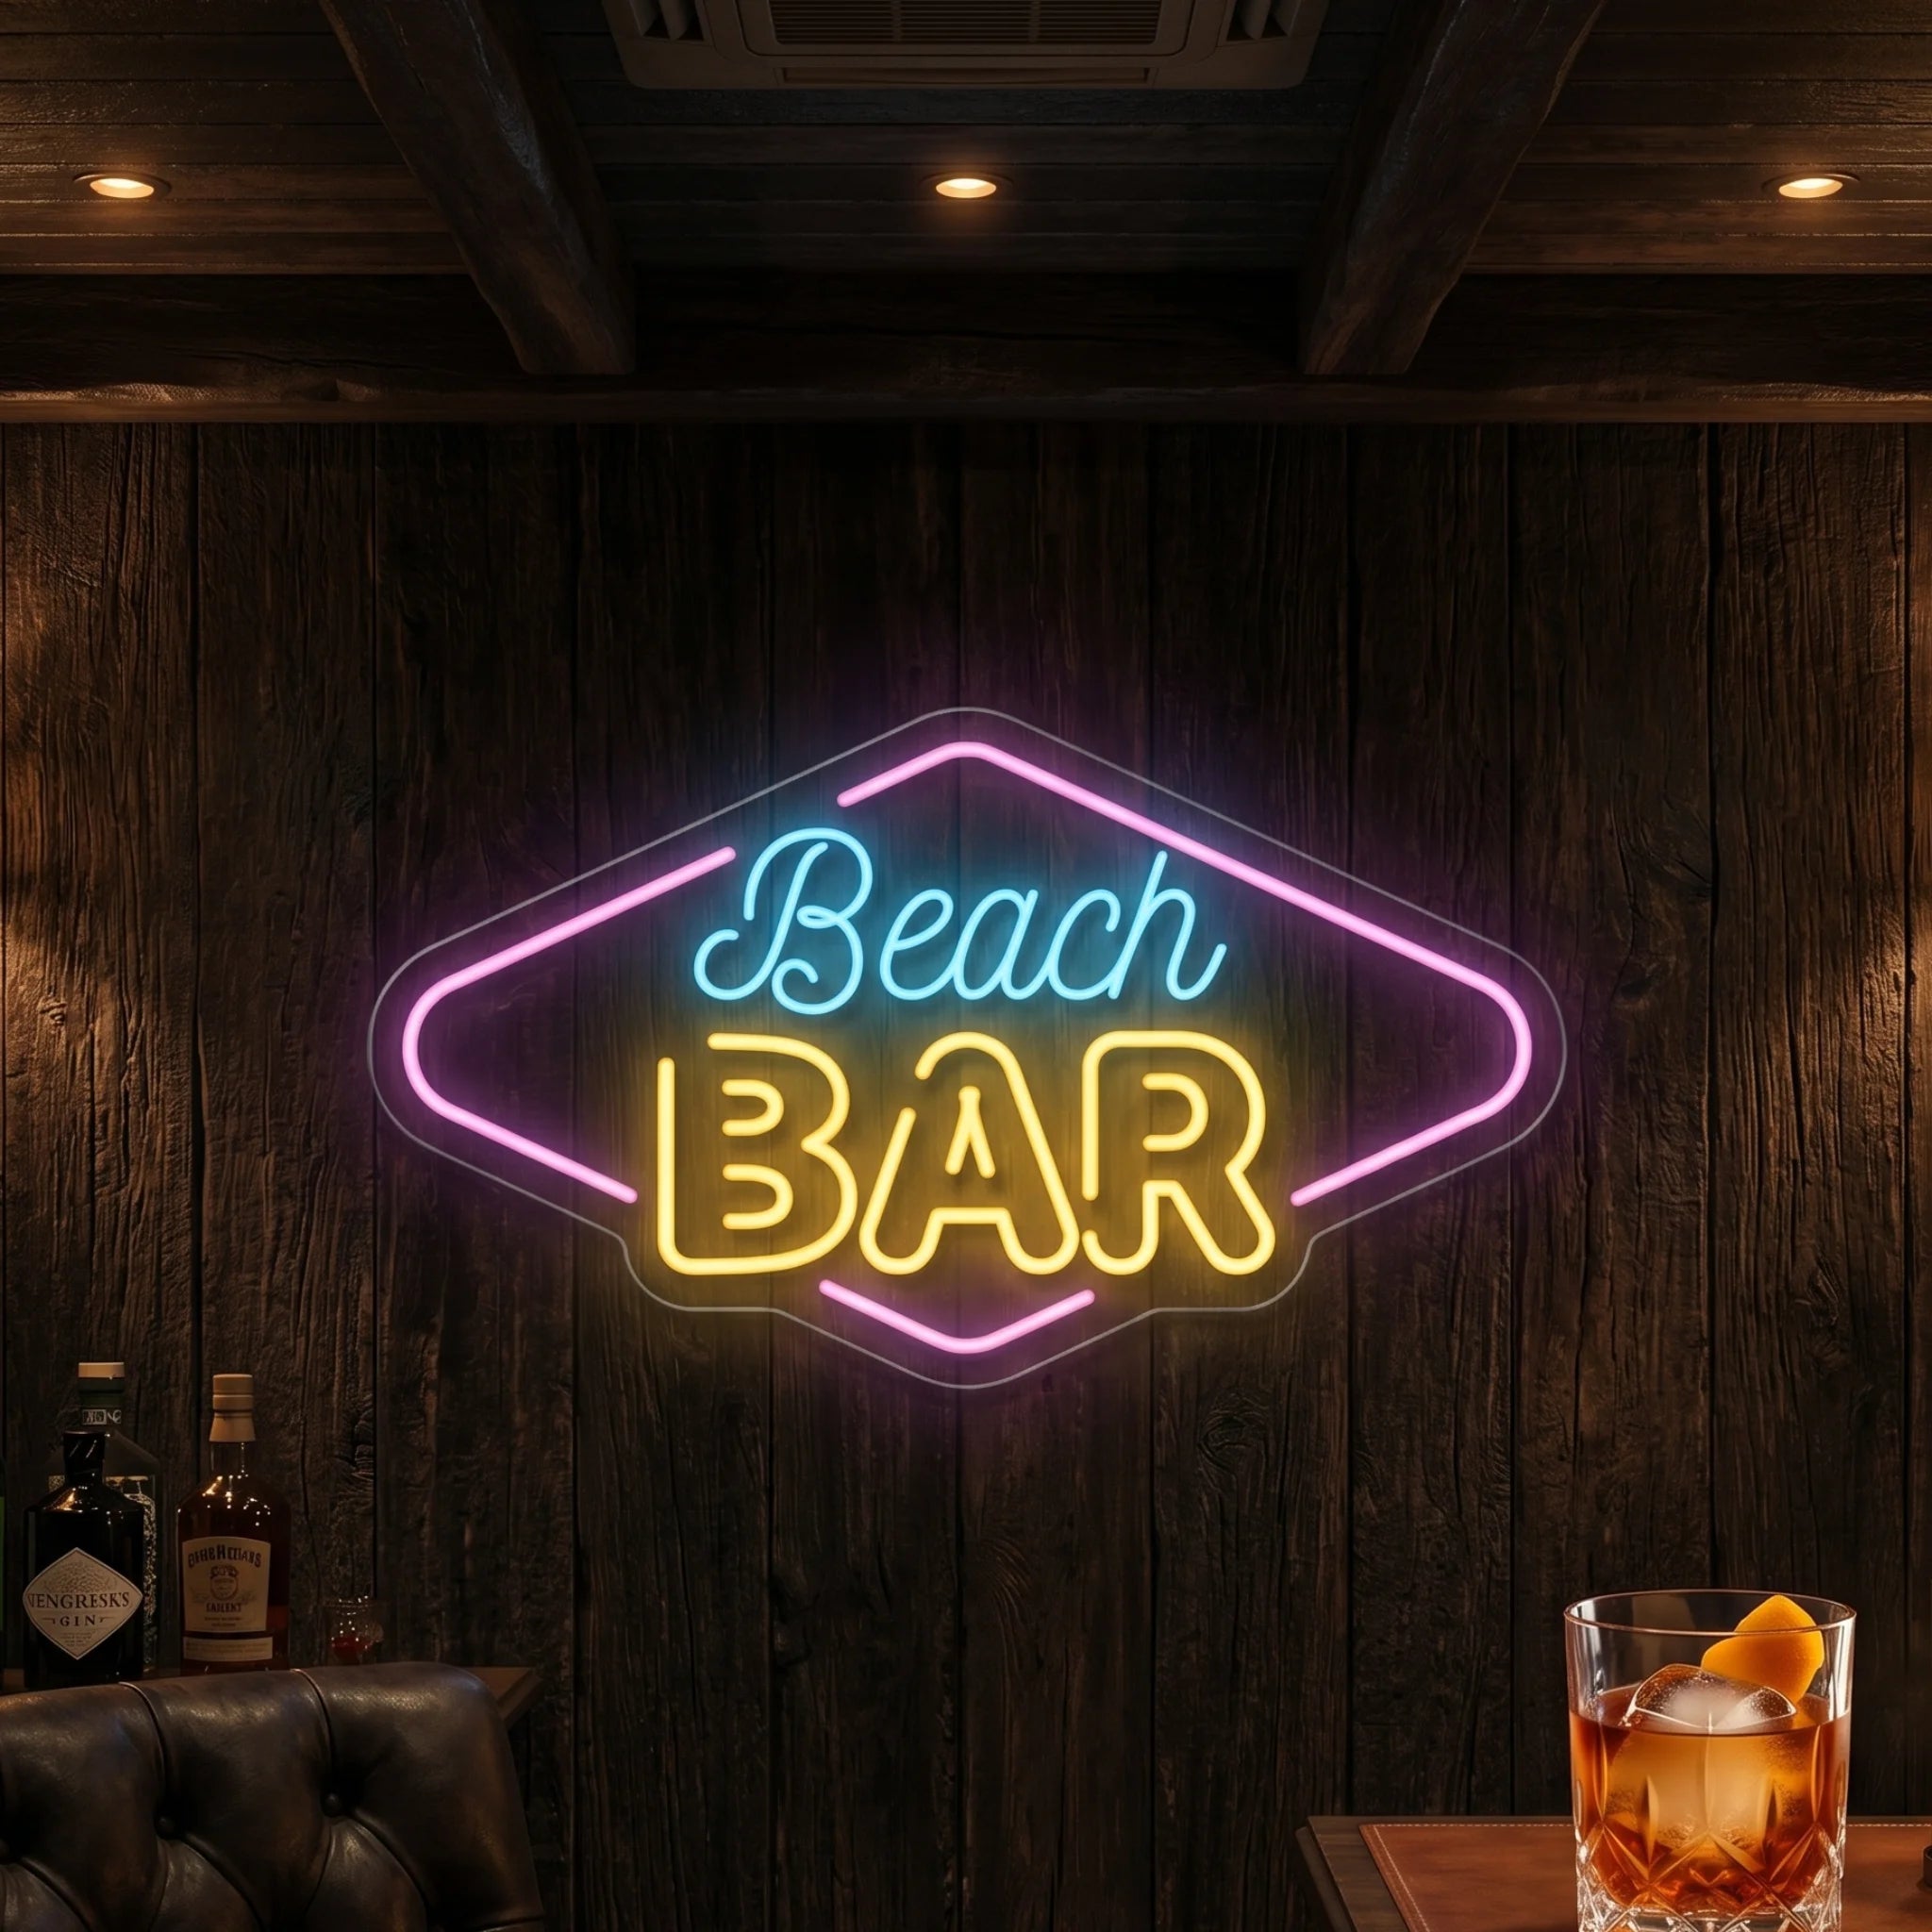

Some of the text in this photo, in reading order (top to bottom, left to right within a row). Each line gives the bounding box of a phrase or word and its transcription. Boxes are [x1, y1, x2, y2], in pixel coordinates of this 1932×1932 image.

[694, 827, 1226, 1015] Beach
[657, 1030, 1275, 1275] BAR
[59, 1615, 95, 1626] GIN
